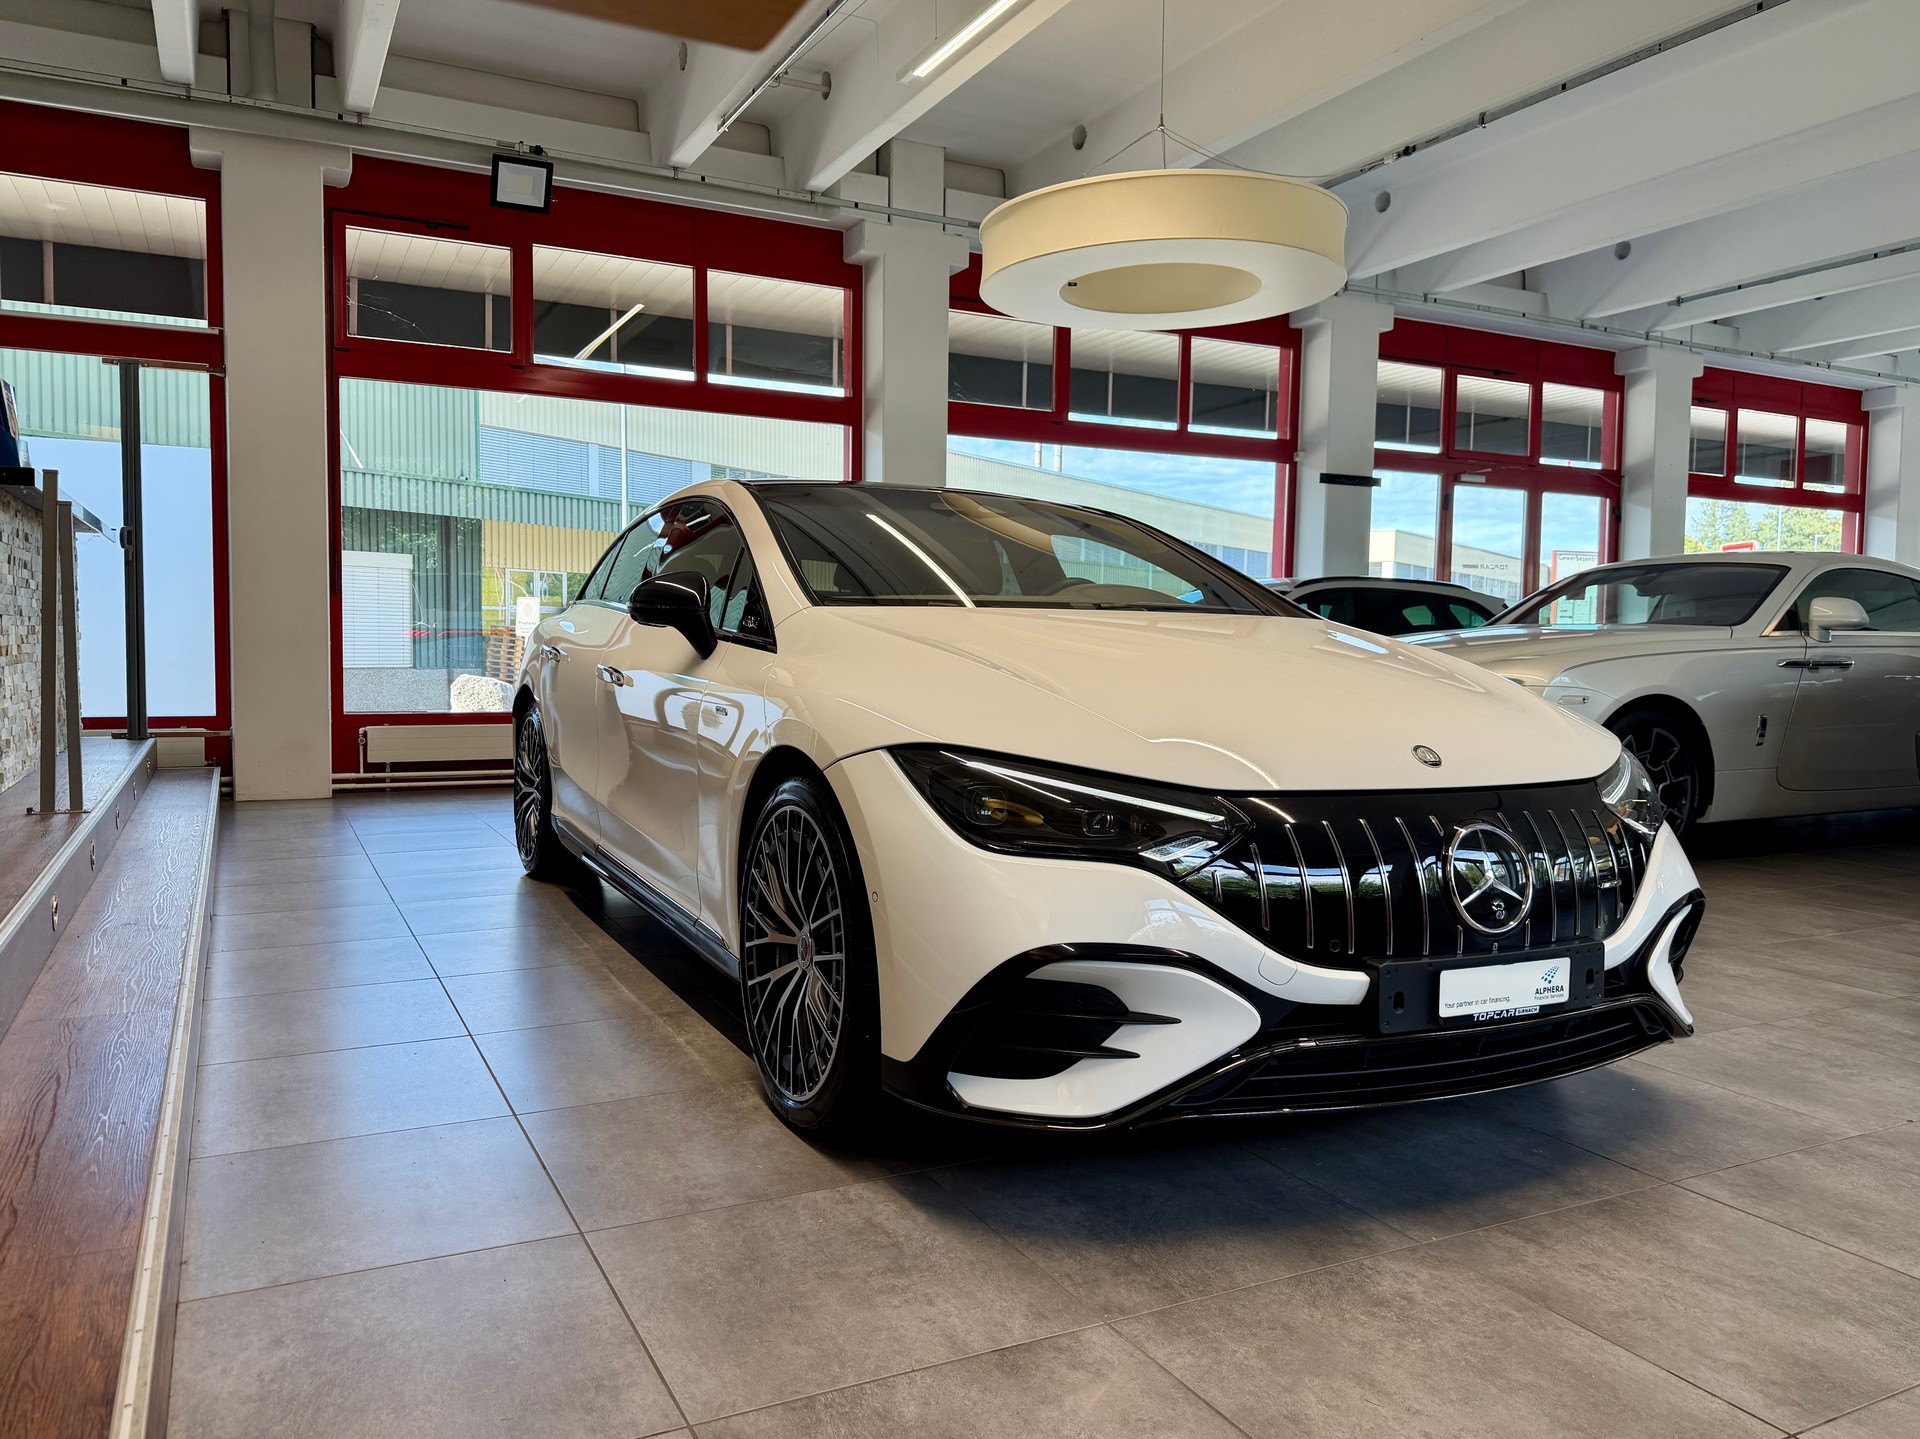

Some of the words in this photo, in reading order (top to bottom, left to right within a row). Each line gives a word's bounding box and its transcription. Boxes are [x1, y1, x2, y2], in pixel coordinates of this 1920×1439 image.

[1534, 985, 1564, 995] ALPHERA
[1456, 1000, 1474, 1008] partner
[1473, 1009, 1516, 1021] TOPCAR
